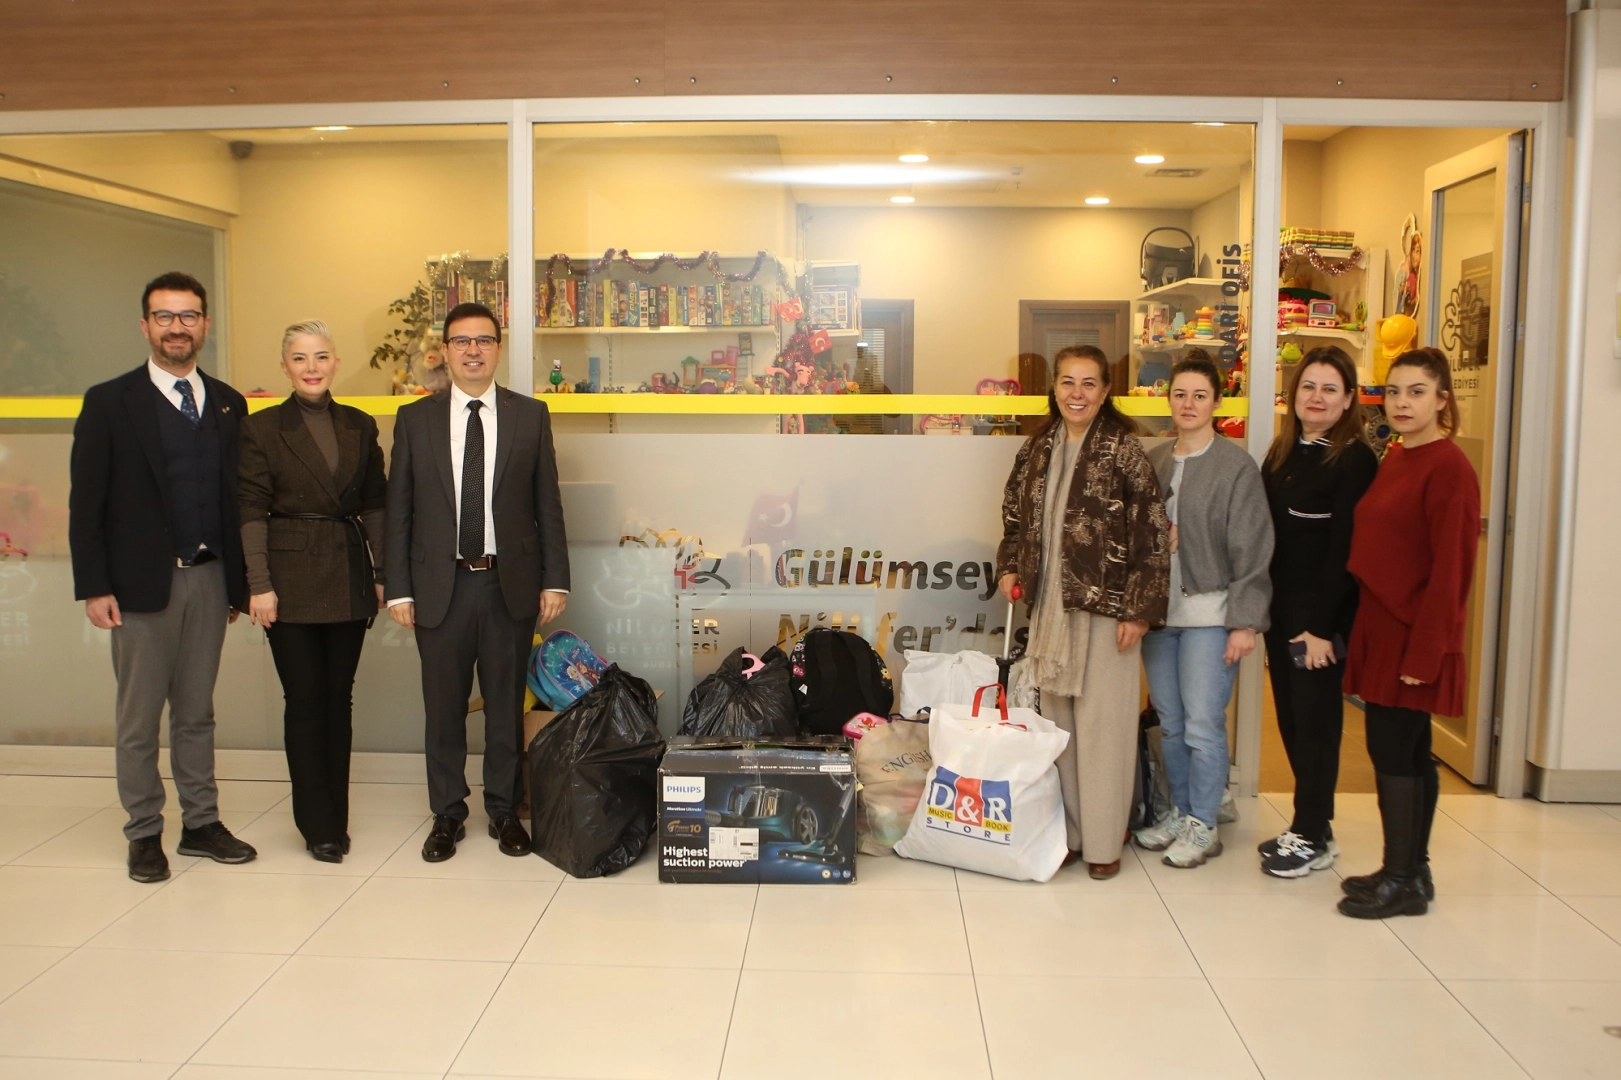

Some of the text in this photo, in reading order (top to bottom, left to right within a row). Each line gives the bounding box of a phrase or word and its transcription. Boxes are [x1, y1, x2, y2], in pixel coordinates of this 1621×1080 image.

[1216, 244, 1241, 297] OFİS
[930, 782, 1008, 824] D&R
[690, 824, 702, 833] 10
[926, 816, 1011, 842] STORE
[928, 808, 1009, 832] MUSIC BOOK
[663, 846, 708, 858] Highest
[663, 857, 706, 867] suction
